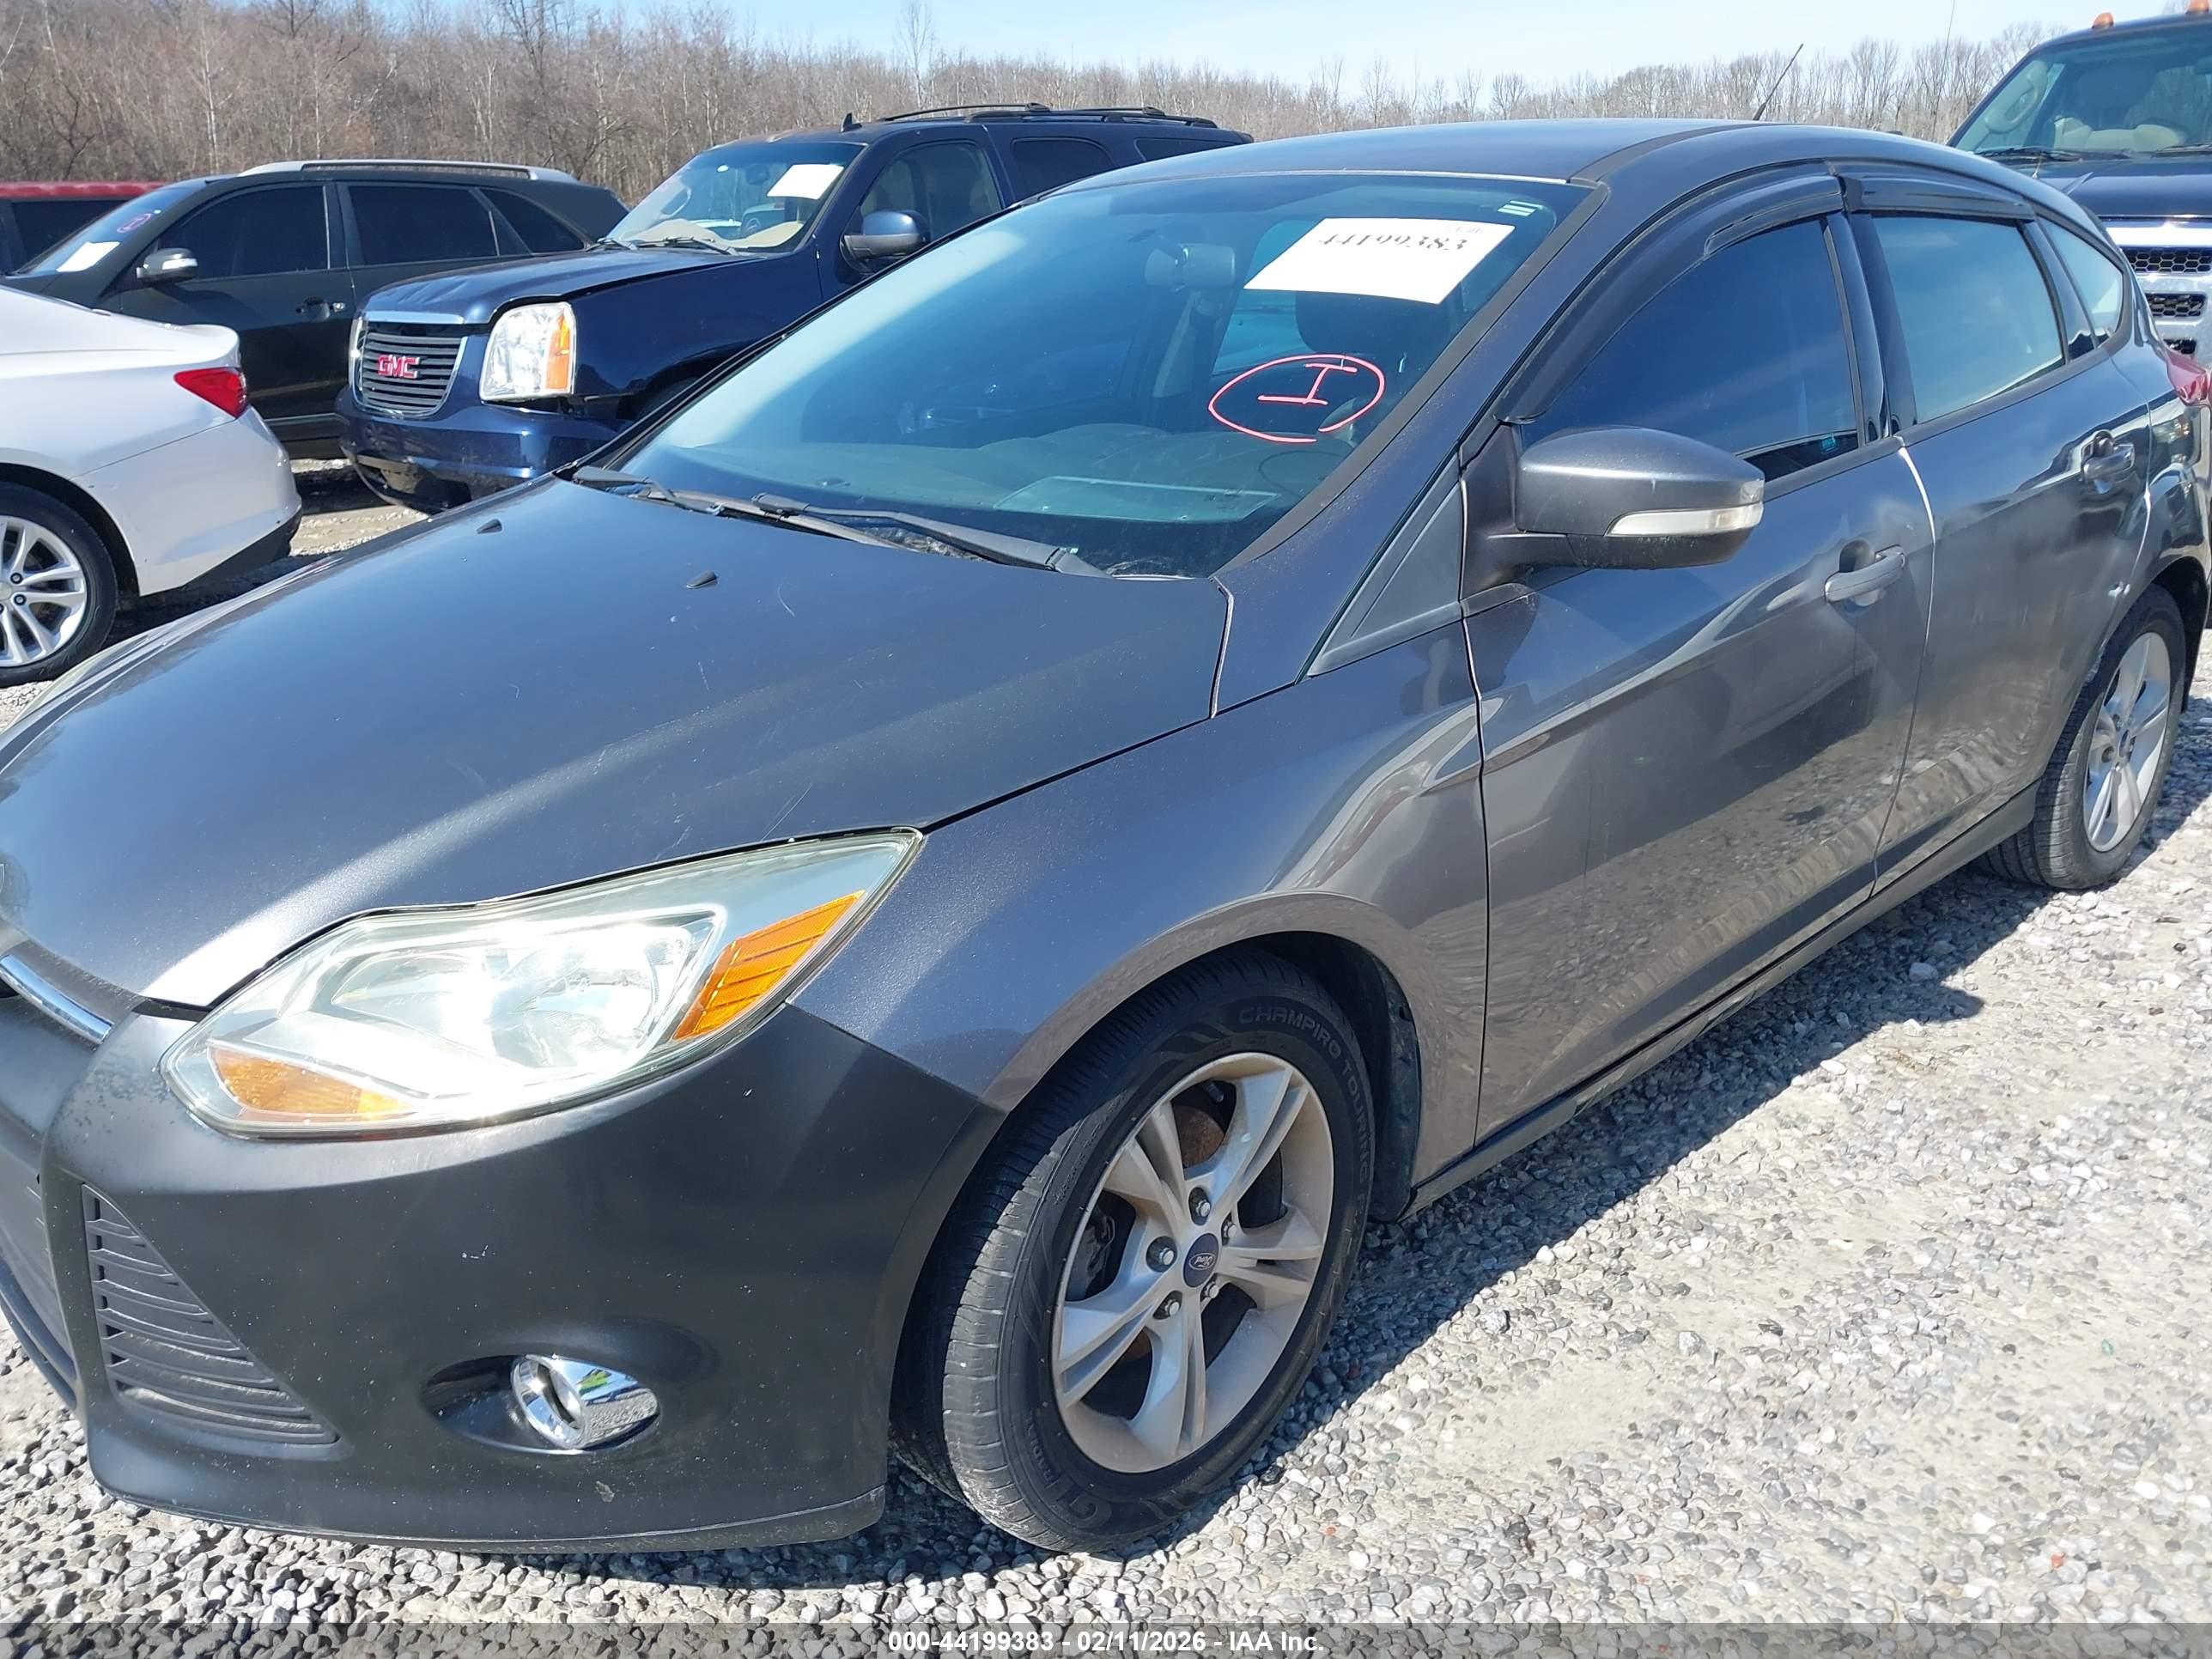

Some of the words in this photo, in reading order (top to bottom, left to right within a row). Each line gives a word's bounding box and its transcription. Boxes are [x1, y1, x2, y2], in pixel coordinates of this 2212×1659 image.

[378, 355, 420, 379] GMC
[1238, 1006, 1341, 1059] CHAMPIRO
[1342, 1059, 1370, 1183] TOURING
